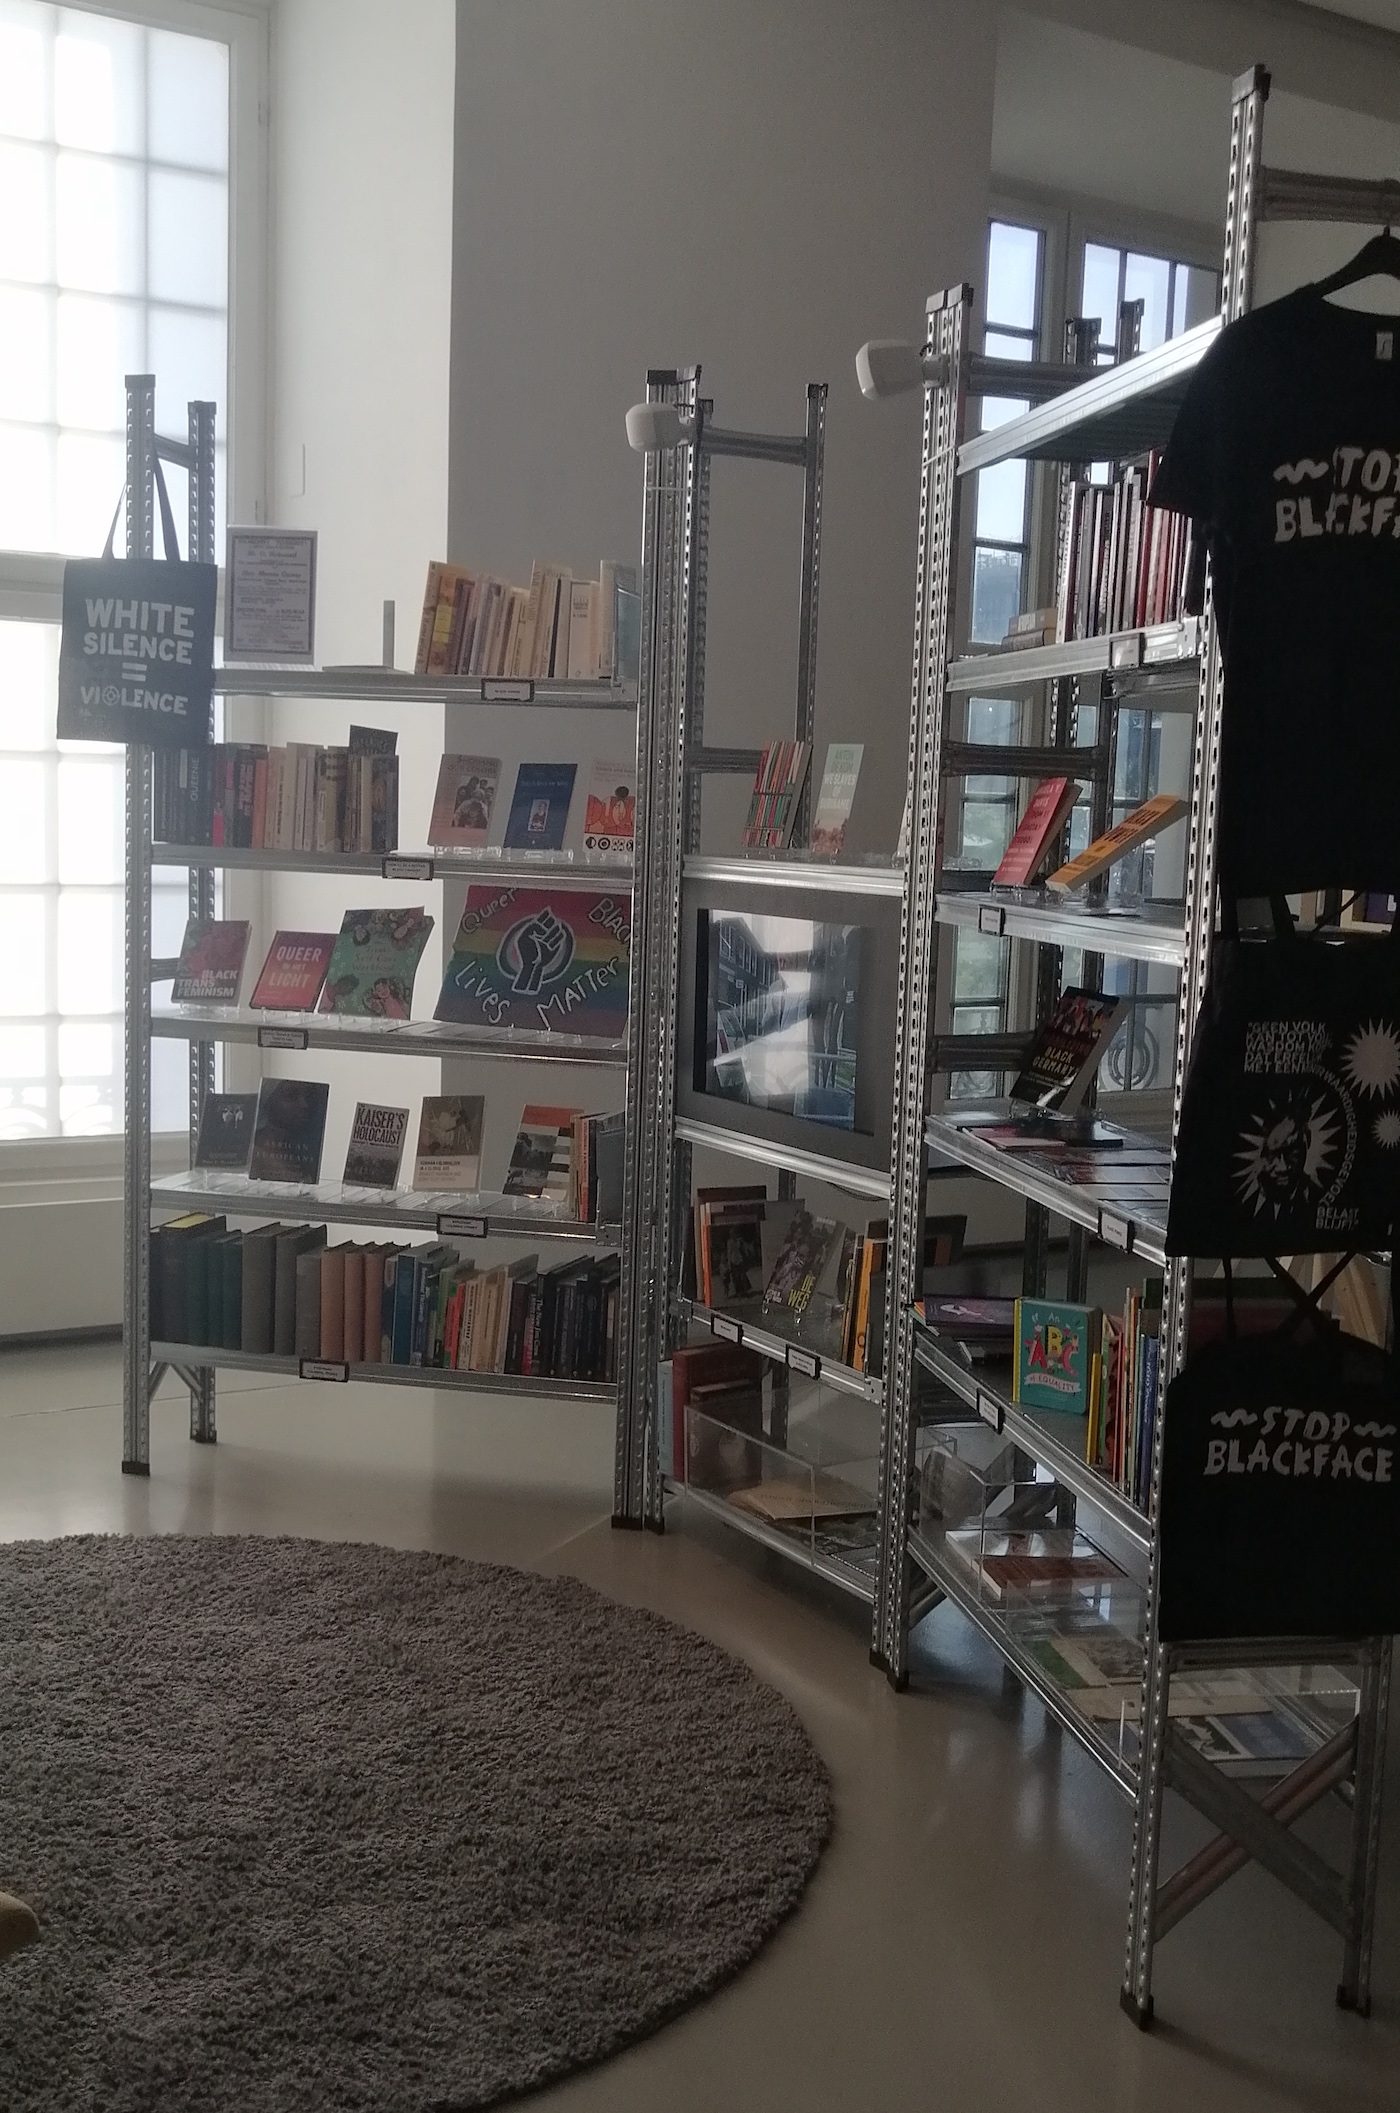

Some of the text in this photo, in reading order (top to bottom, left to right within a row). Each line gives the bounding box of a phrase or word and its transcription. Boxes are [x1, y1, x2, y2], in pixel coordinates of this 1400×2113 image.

[85, 598, 196, 639] WHITE
[83, 631, 194, 665] SILENCE
[80, 686, 190, 716] VIOLENCE
[276, 945, 322, 963] QUEER
[178, 978, 216, 989] TRANS
[202, 969, 239, 981] BLACK
[268, 973, 312, 989] LICHT
[177, 987, 235, 999] FEMINISM
[356, 1108, 405, 1130] KAISER'S
[353, 1126, 402, 1145] HOLOCAUST
[1028, 1324, 1080, 1376] ABC
[1260, 1406, 1351, 1442] STOP
[1203, 1438, 1394, 1483] BLACKFACE
